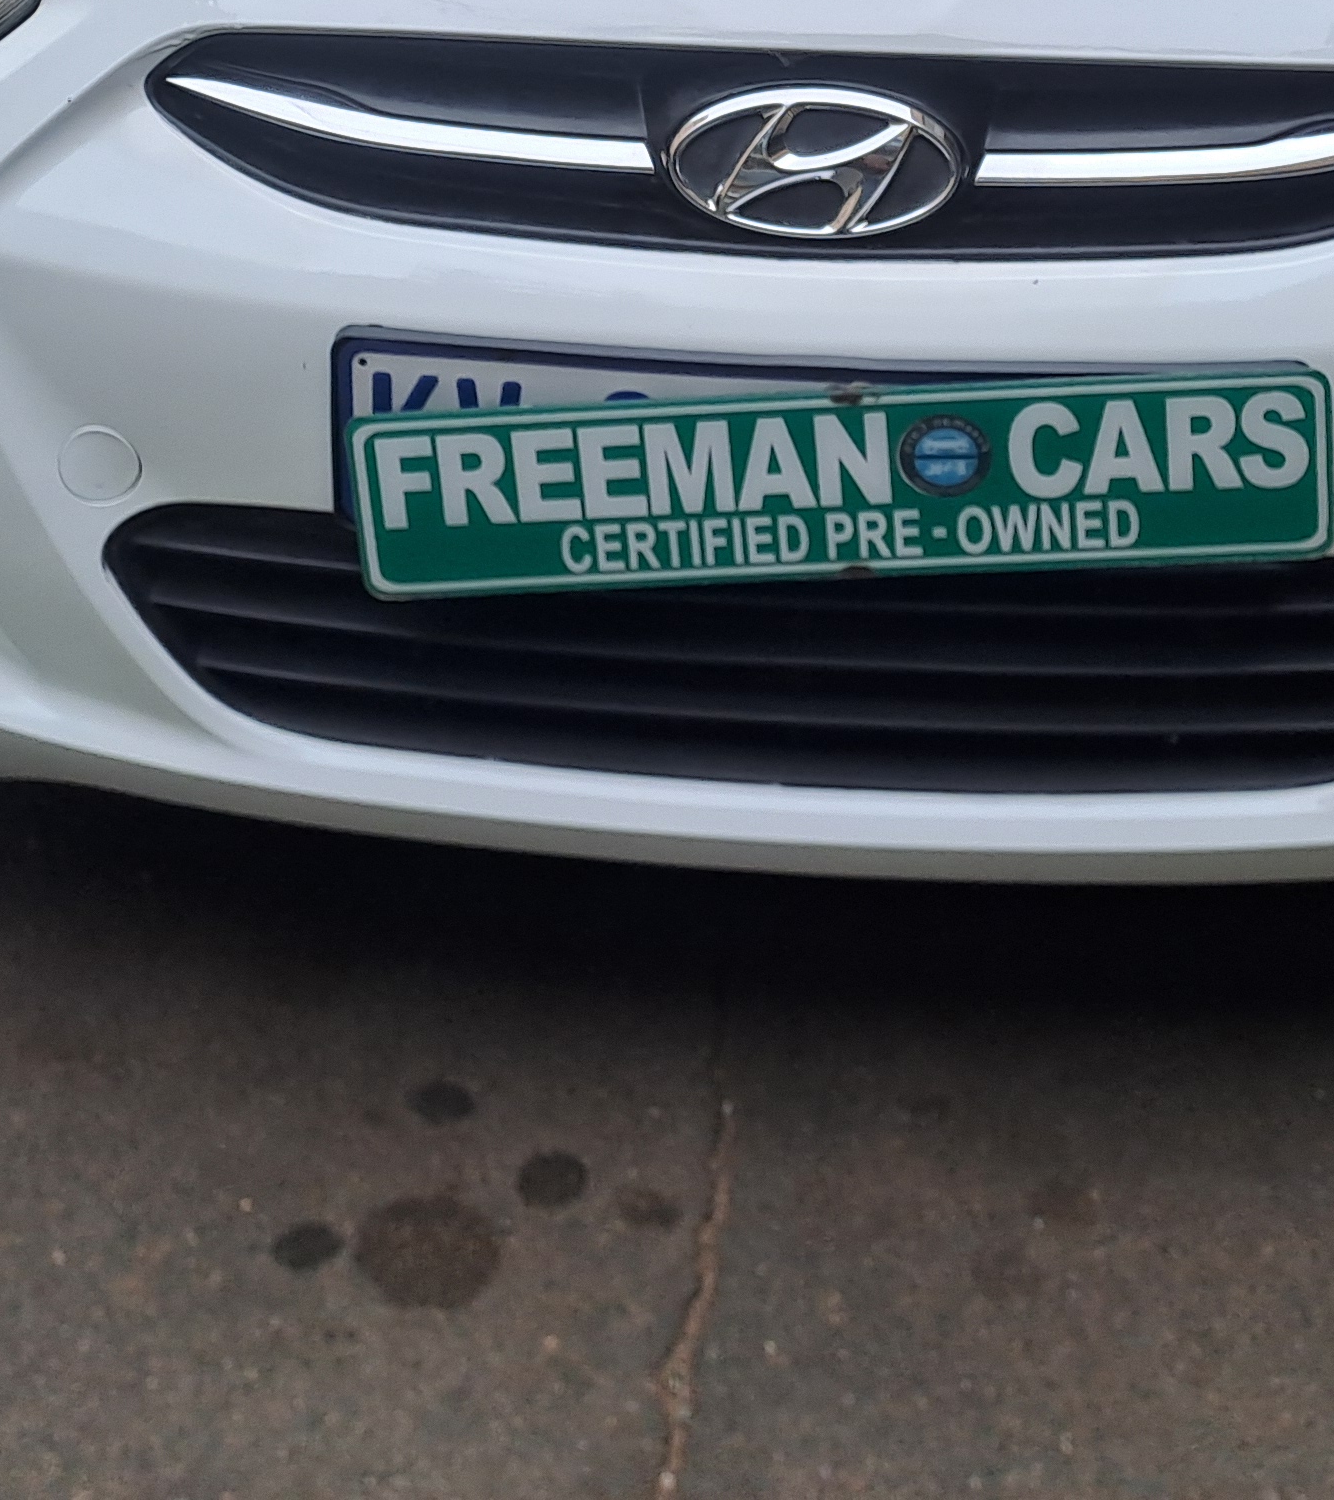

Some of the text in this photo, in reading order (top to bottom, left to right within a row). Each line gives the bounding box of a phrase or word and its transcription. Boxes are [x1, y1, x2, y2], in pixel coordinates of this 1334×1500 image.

[372, 390, 1310, 531] FREEMAN CARS
[560, 512, 810, 575] CERTIFIED
